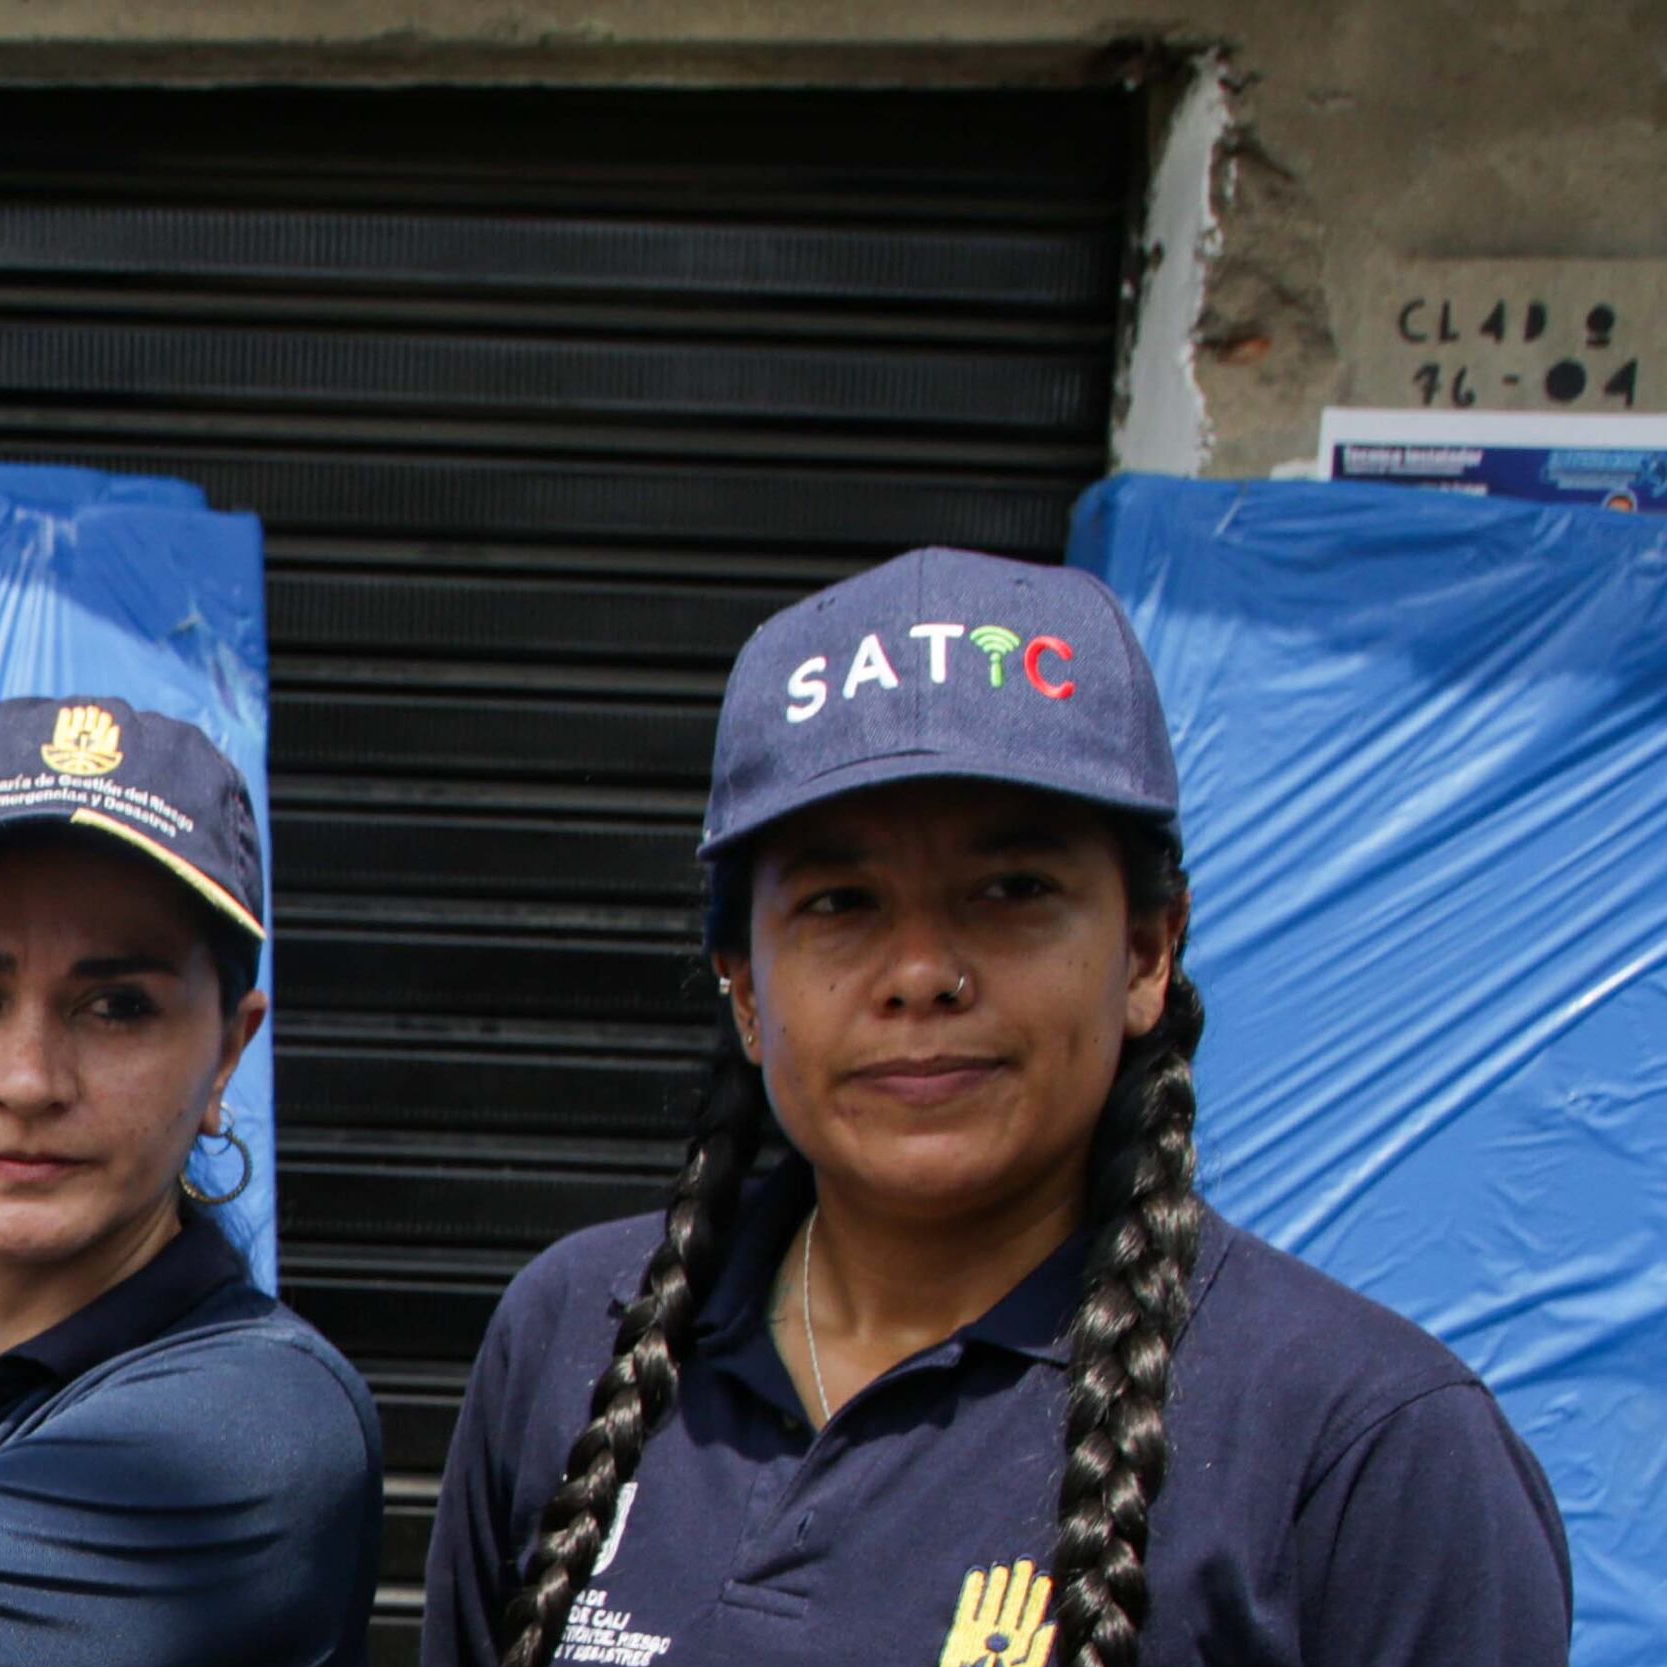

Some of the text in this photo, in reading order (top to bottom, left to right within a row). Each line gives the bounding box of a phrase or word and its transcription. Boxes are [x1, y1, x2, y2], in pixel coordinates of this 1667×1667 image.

[34, 772, 55, 788] de
[124, 787, 148, 806] del
[91, 793, 103, 808] y
[592, 1609, 632, 1630] CALI
